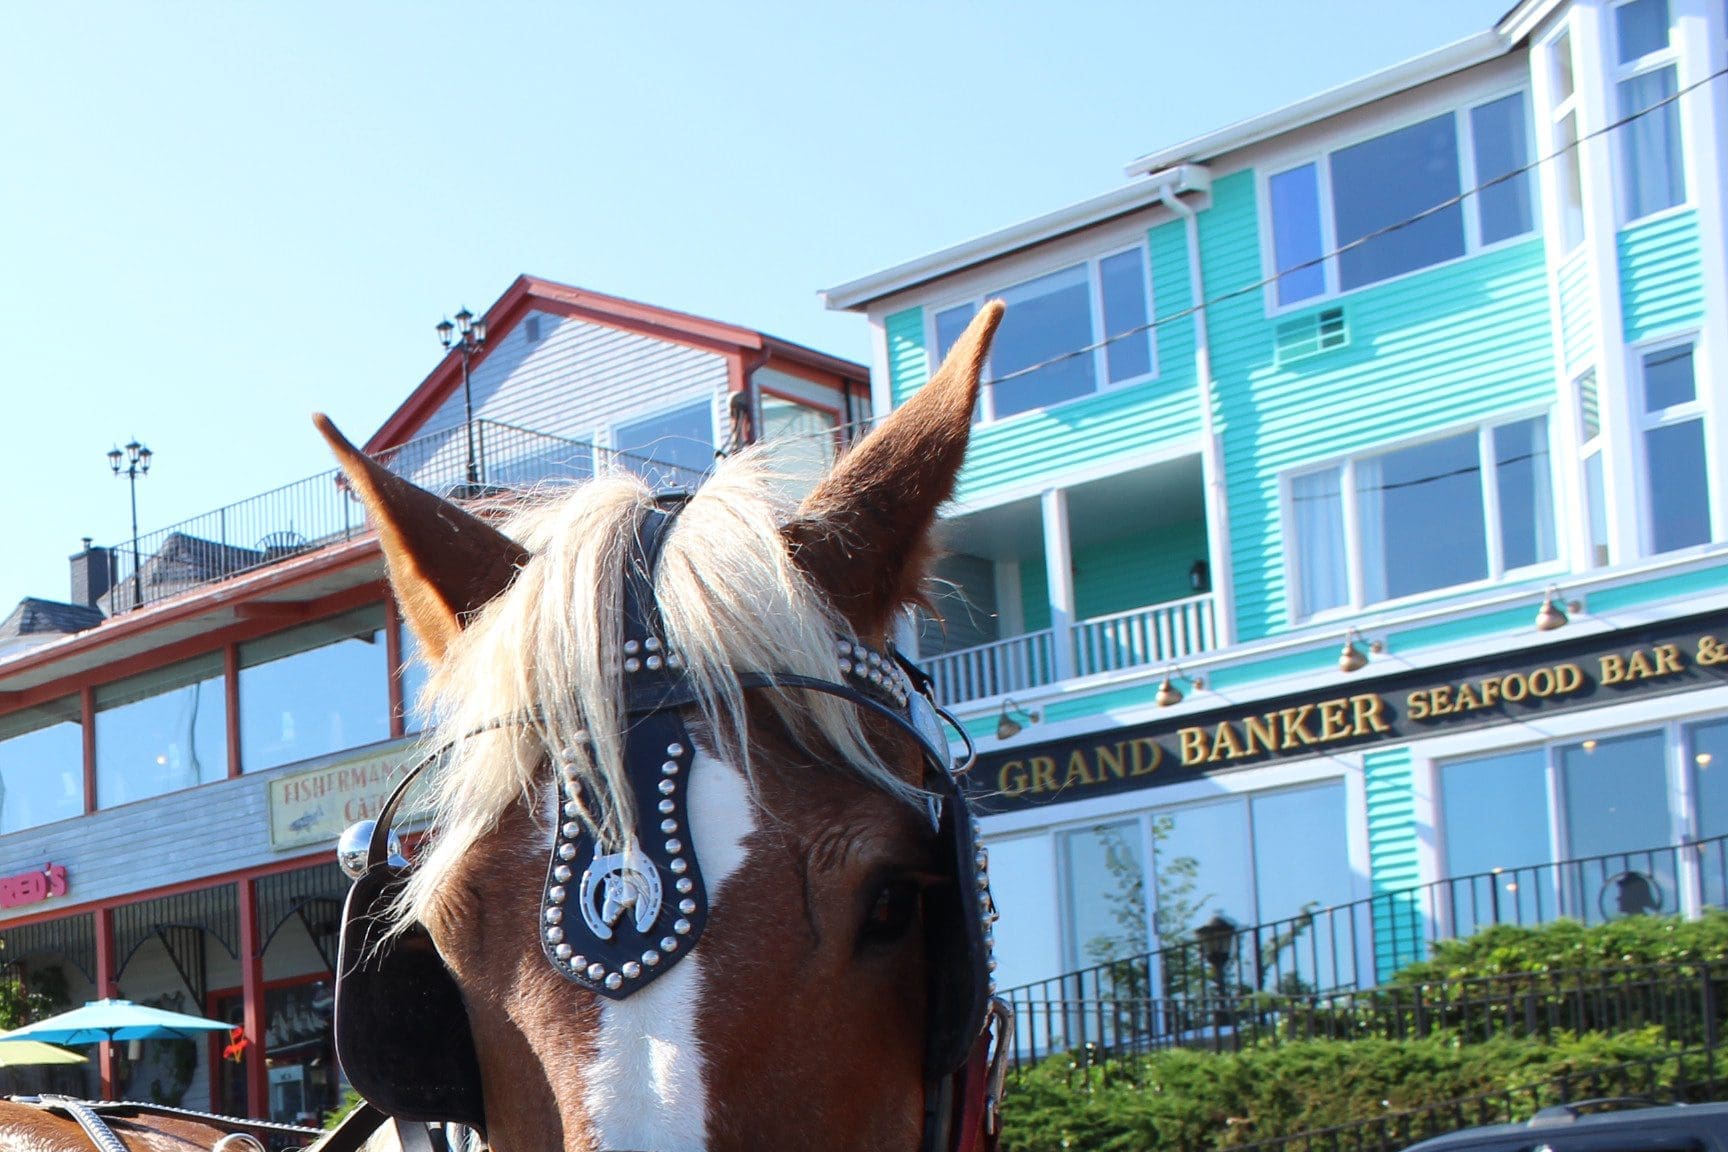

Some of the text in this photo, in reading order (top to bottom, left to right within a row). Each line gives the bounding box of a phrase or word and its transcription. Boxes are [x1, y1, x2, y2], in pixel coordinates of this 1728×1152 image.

[997, 634, 1728, 798] GRAND BANKER SEAFOOD BAR &
